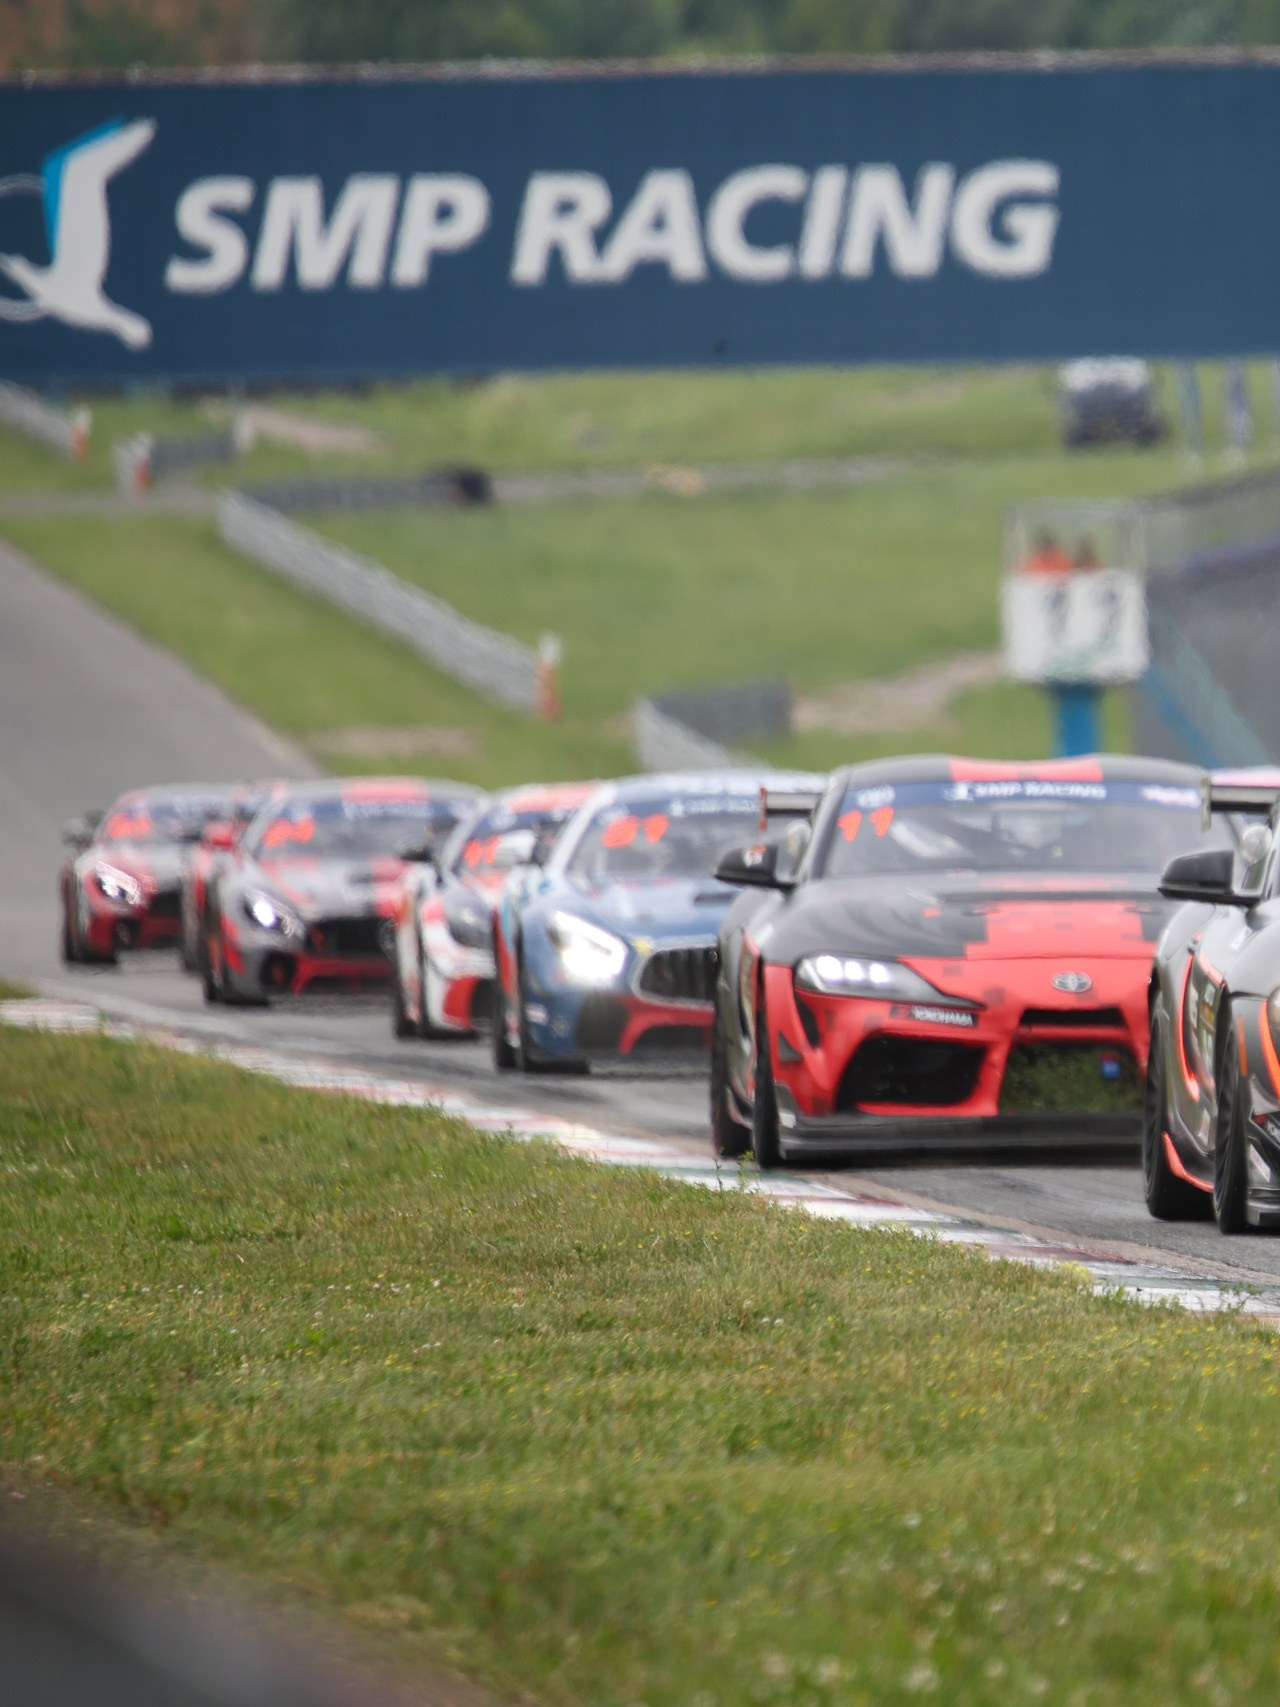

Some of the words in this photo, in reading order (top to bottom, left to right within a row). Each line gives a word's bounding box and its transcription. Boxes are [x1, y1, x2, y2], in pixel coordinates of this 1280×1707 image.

[165, 172, 493, 292] SMP
[511, 159, 1060, 286] RACING
[838, 804, 895, 842] 11
[911, 1005, 974, 1027] YOKOHAMA
